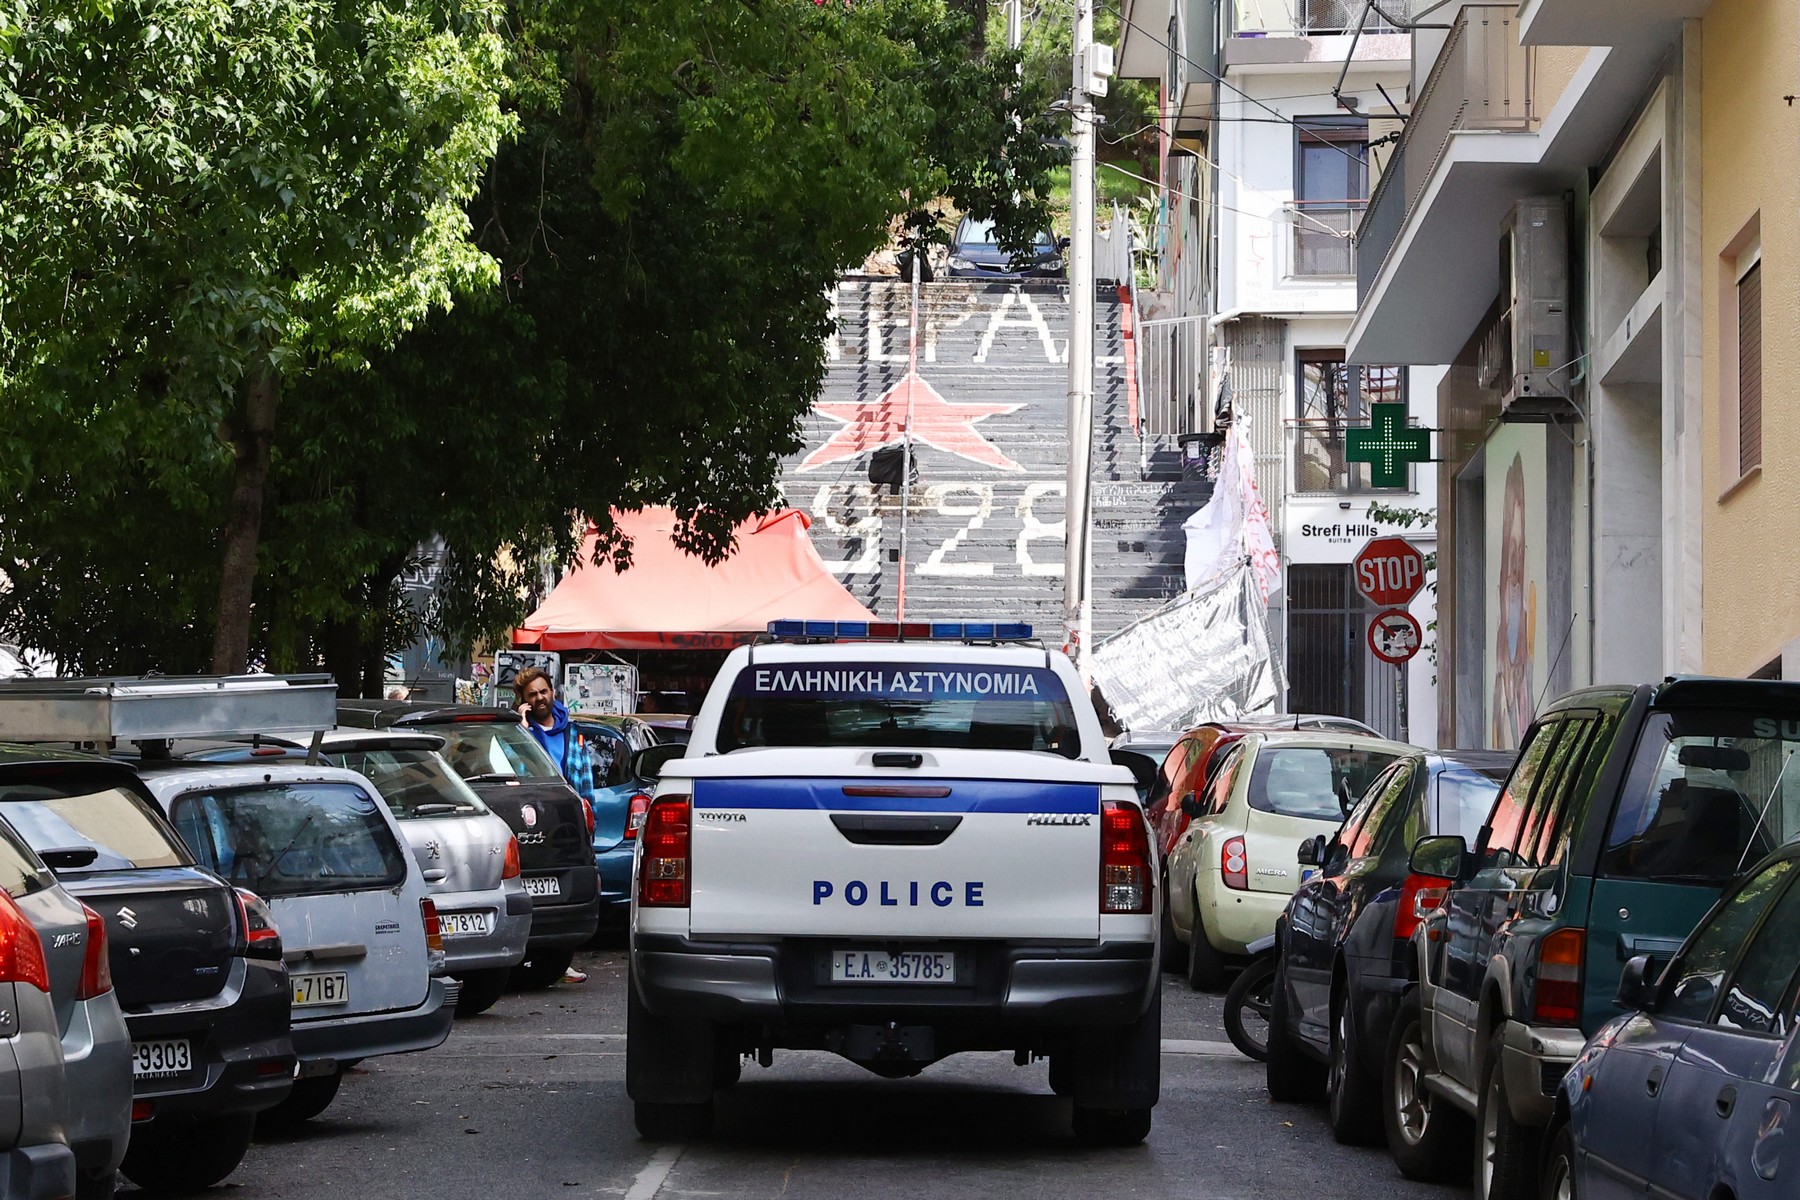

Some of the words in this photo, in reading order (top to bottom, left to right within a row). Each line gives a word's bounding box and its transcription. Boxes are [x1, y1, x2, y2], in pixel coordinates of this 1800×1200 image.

[1301, 524, 1341, 537] Strefi
[1346, 524, 1378, 537] Hills
[1360, 555, 1419, 592] STOP
[755, 670, 883, 692] ΕΛΛΗΝΙΚΗ
[889, 672, 1039, 695] ΑΣΤΥΝΟΜΙΑ
[699, 812, 747, 823] TOYOTA
[1027, 812, 1092, 827] HILUX
[1256, 868, 1288, 877] MICRA
[812, 880, 985, 907] POLICE
[52, 931, 82, 948] YARIS
[889, 954, 945, 979] 35785
